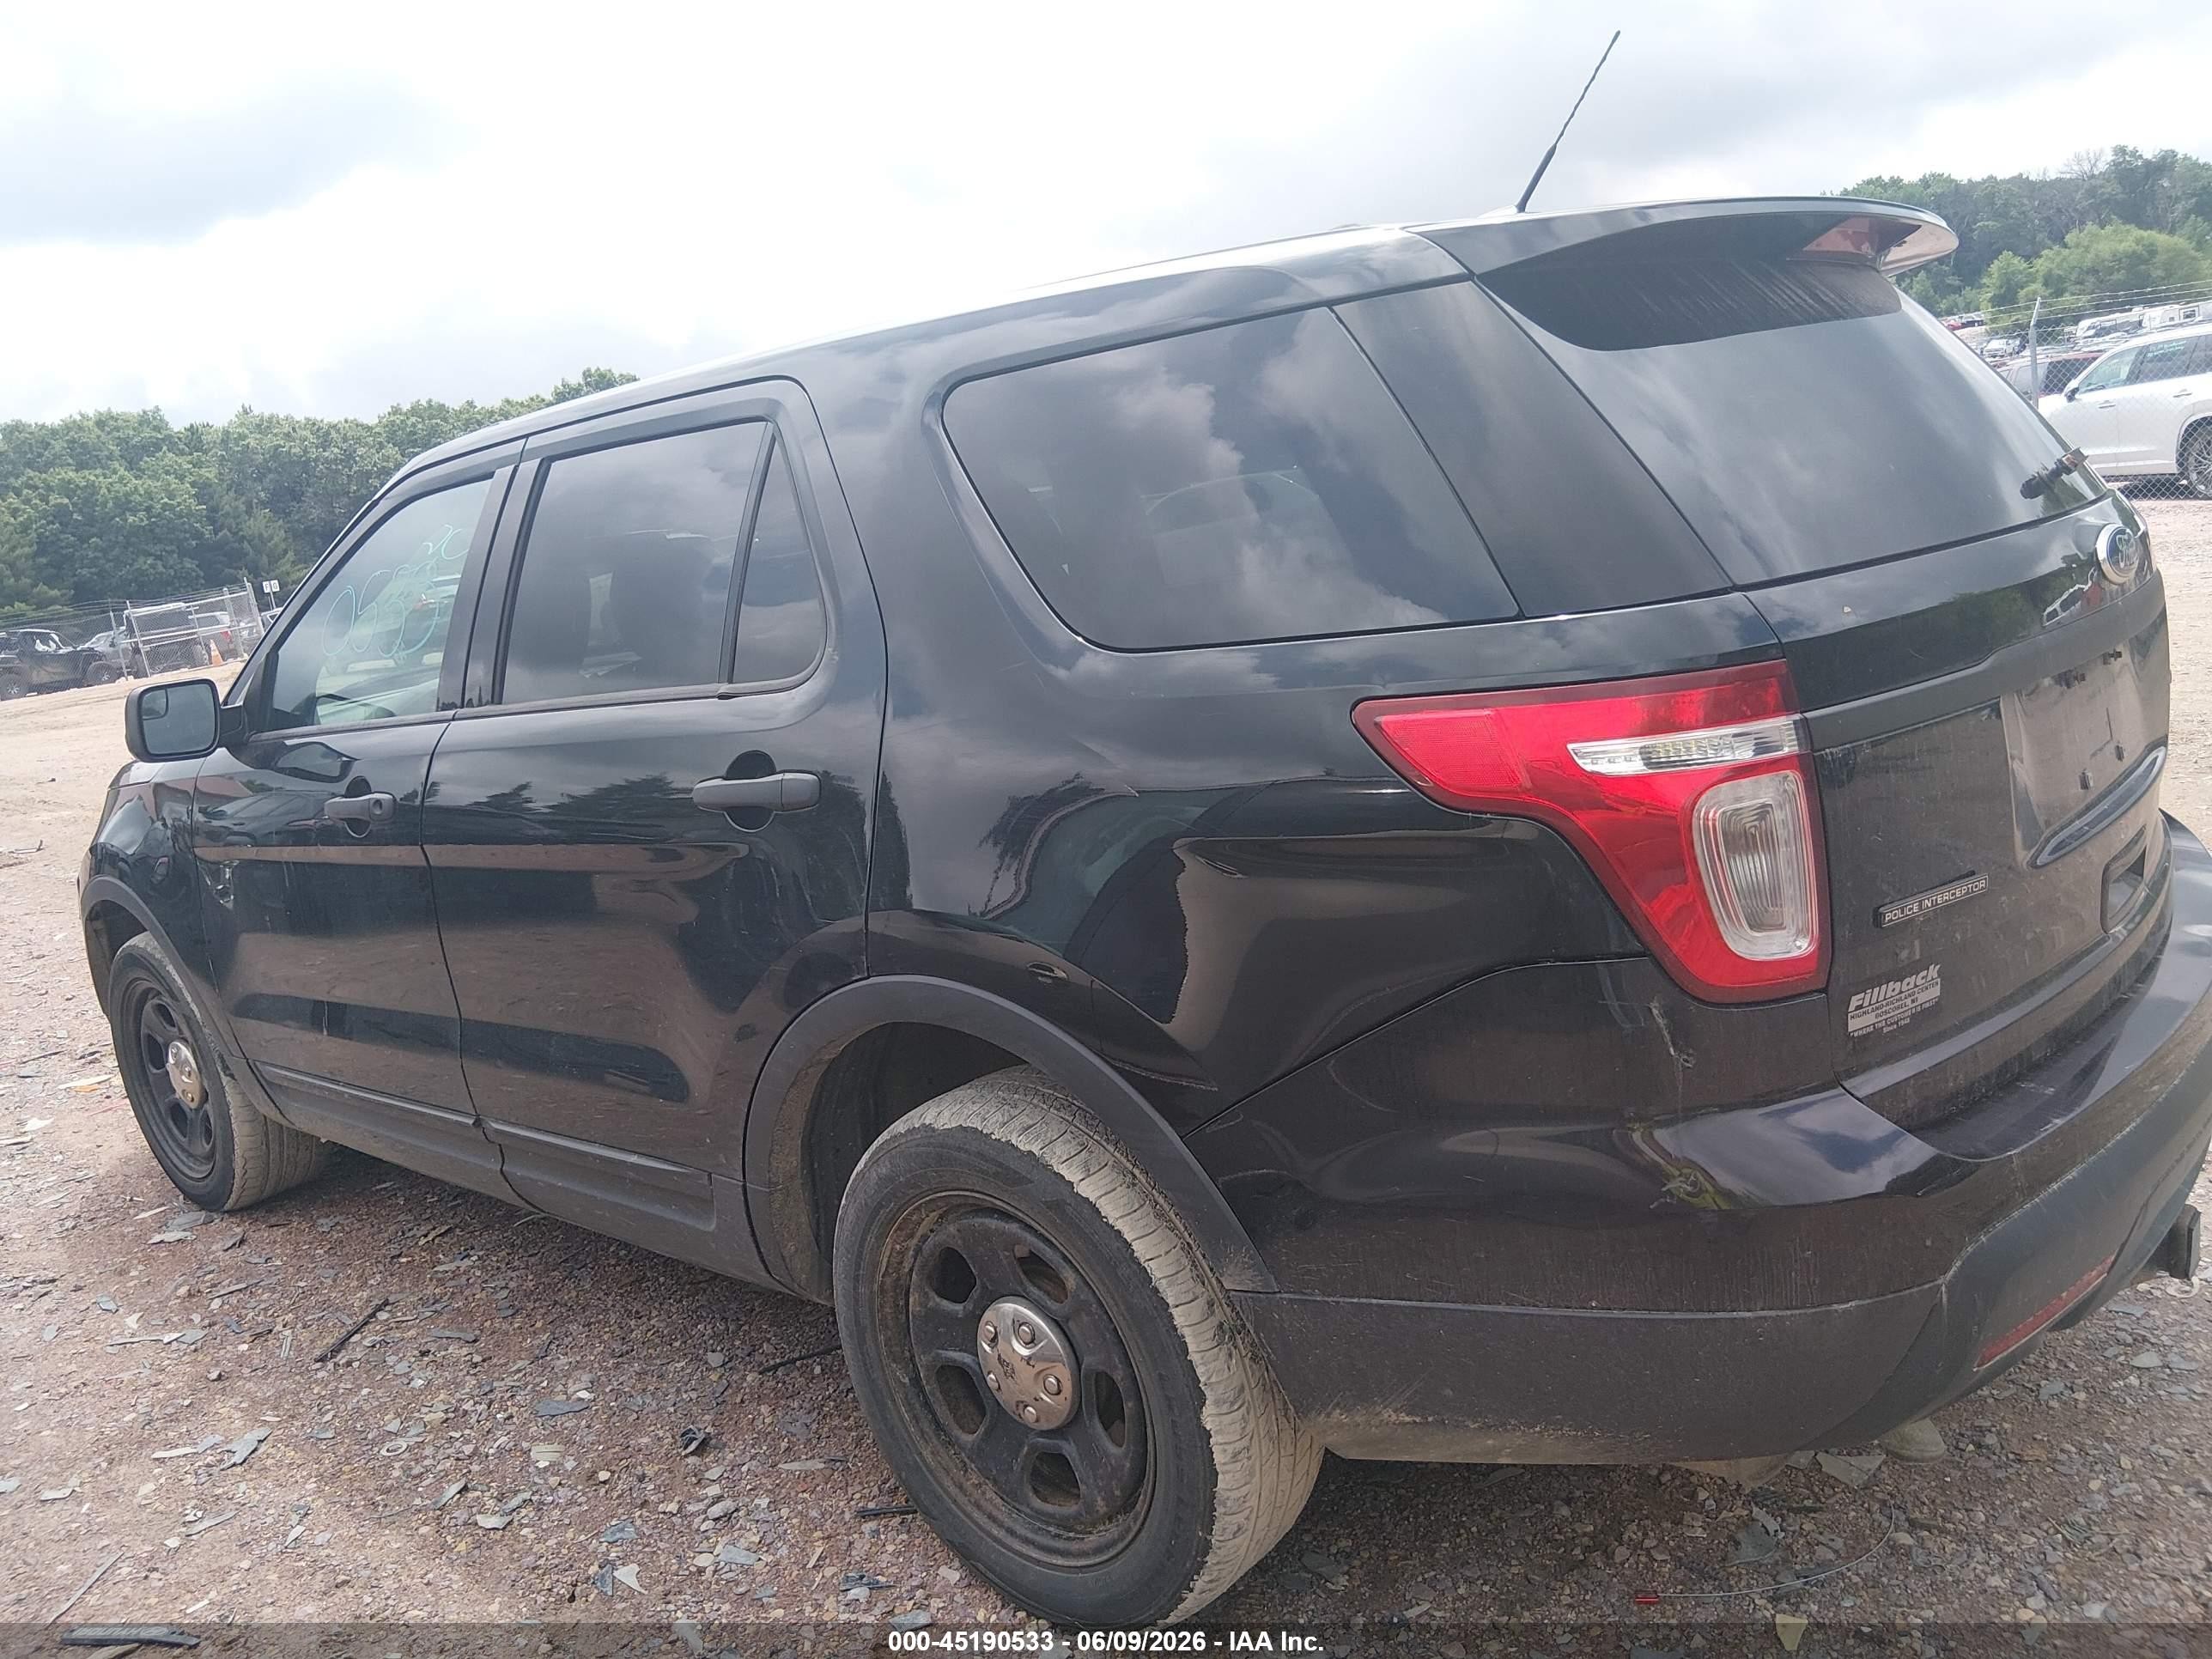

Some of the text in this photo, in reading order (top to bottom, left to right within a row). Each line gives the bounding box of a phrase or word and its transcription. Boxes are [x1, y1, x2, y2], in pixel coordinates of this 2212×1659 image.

[1884, 879, 1986, 923] POLICE INTERCEPTOR
[1848, 963, 1941, 1012] Fillback
